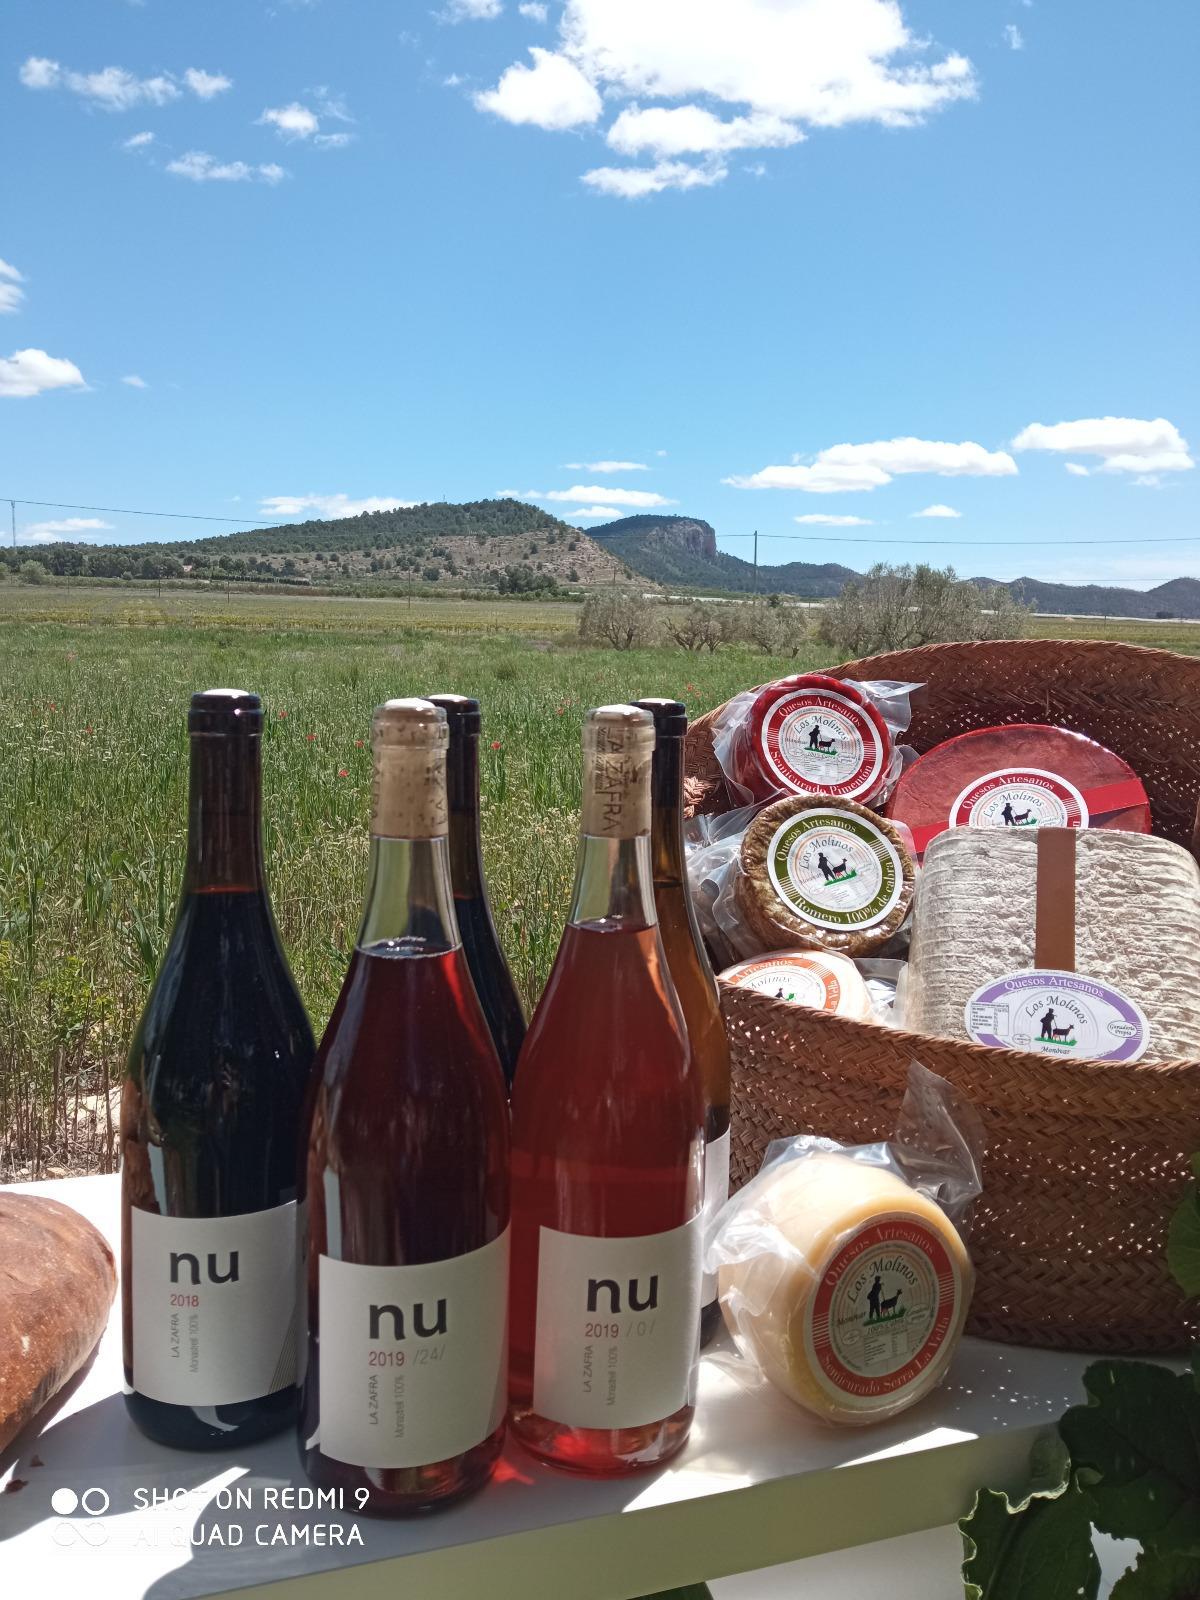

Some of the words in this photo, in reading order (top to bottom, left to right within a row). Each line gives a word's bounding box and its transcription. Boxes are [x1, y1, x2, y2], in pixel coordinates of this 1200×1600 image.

[778, 699, 813, 718] Quesos
[815, 696, 862, 727] Artesanos
[793, 719, 810, 735] Los
[812, 715, 849, 741] Molinos
[770, 751, 828, 794] Semicurado
[829, 762, 873, 796] Pimentón
[601, 761, 624, 831] ZAFRA
[962, 781, 996, 810] Quesos
[998, 775, 1055, 791] Artesanos
[983, 801, 1000, 818] Los
[1000, 790, 1045, 807] Molinos
[776, 827, 801, 861] Quesos
[803, 819, 857, 833] Artesanos
[799, 853, 812, 870] Los
[810, 834, 854, 854] Molinos
[794, 897, 841, 924] Romero
[845, 904, 879, 924] 100%
[876, 892, 889, 908] de
[886, 861, 895, 894] cabra
[1004, 977, 1046, 991] Quesos
[1048, 976, 1104, 998] Artesanos
[1025, 999, 1044, 1018] Los
[1046, 995, 1088, 1025] Molinos
[169, 1251, 240, 1285] nu
[825, 1239, 870, 1287] Quesos
[876, 1226, 934, 1255] Artesanos
[586, 1274, 659, 1314] nu
[848, 1272, 867, 1304] Los
[868, 1255, 919, 1287] Molinos
[170, 1294, 200, 1308] 2018
[170, 1312, 180, 1344] ZAFRA
[369, 1298, 448, 1341] nu
[585, 1323, 620, 1338] 2019
[170, 1346, 180, 1359] LA
[368, 1351, 405, 1367] 2019
[583, 1344, 593, 1378] ZAFRA
[822, 1352, 880, 1394] Semicurado
[883, 1369, 915, 1392] Serra
[915, 1353, 931, 1370] La
[928, 1315, 950, 1349] Vella
[369, 1374, 378, 1409] ZAFRA
[583, 1380, 592, 1393] LA
[369, 1411, 378, 1425] LA
